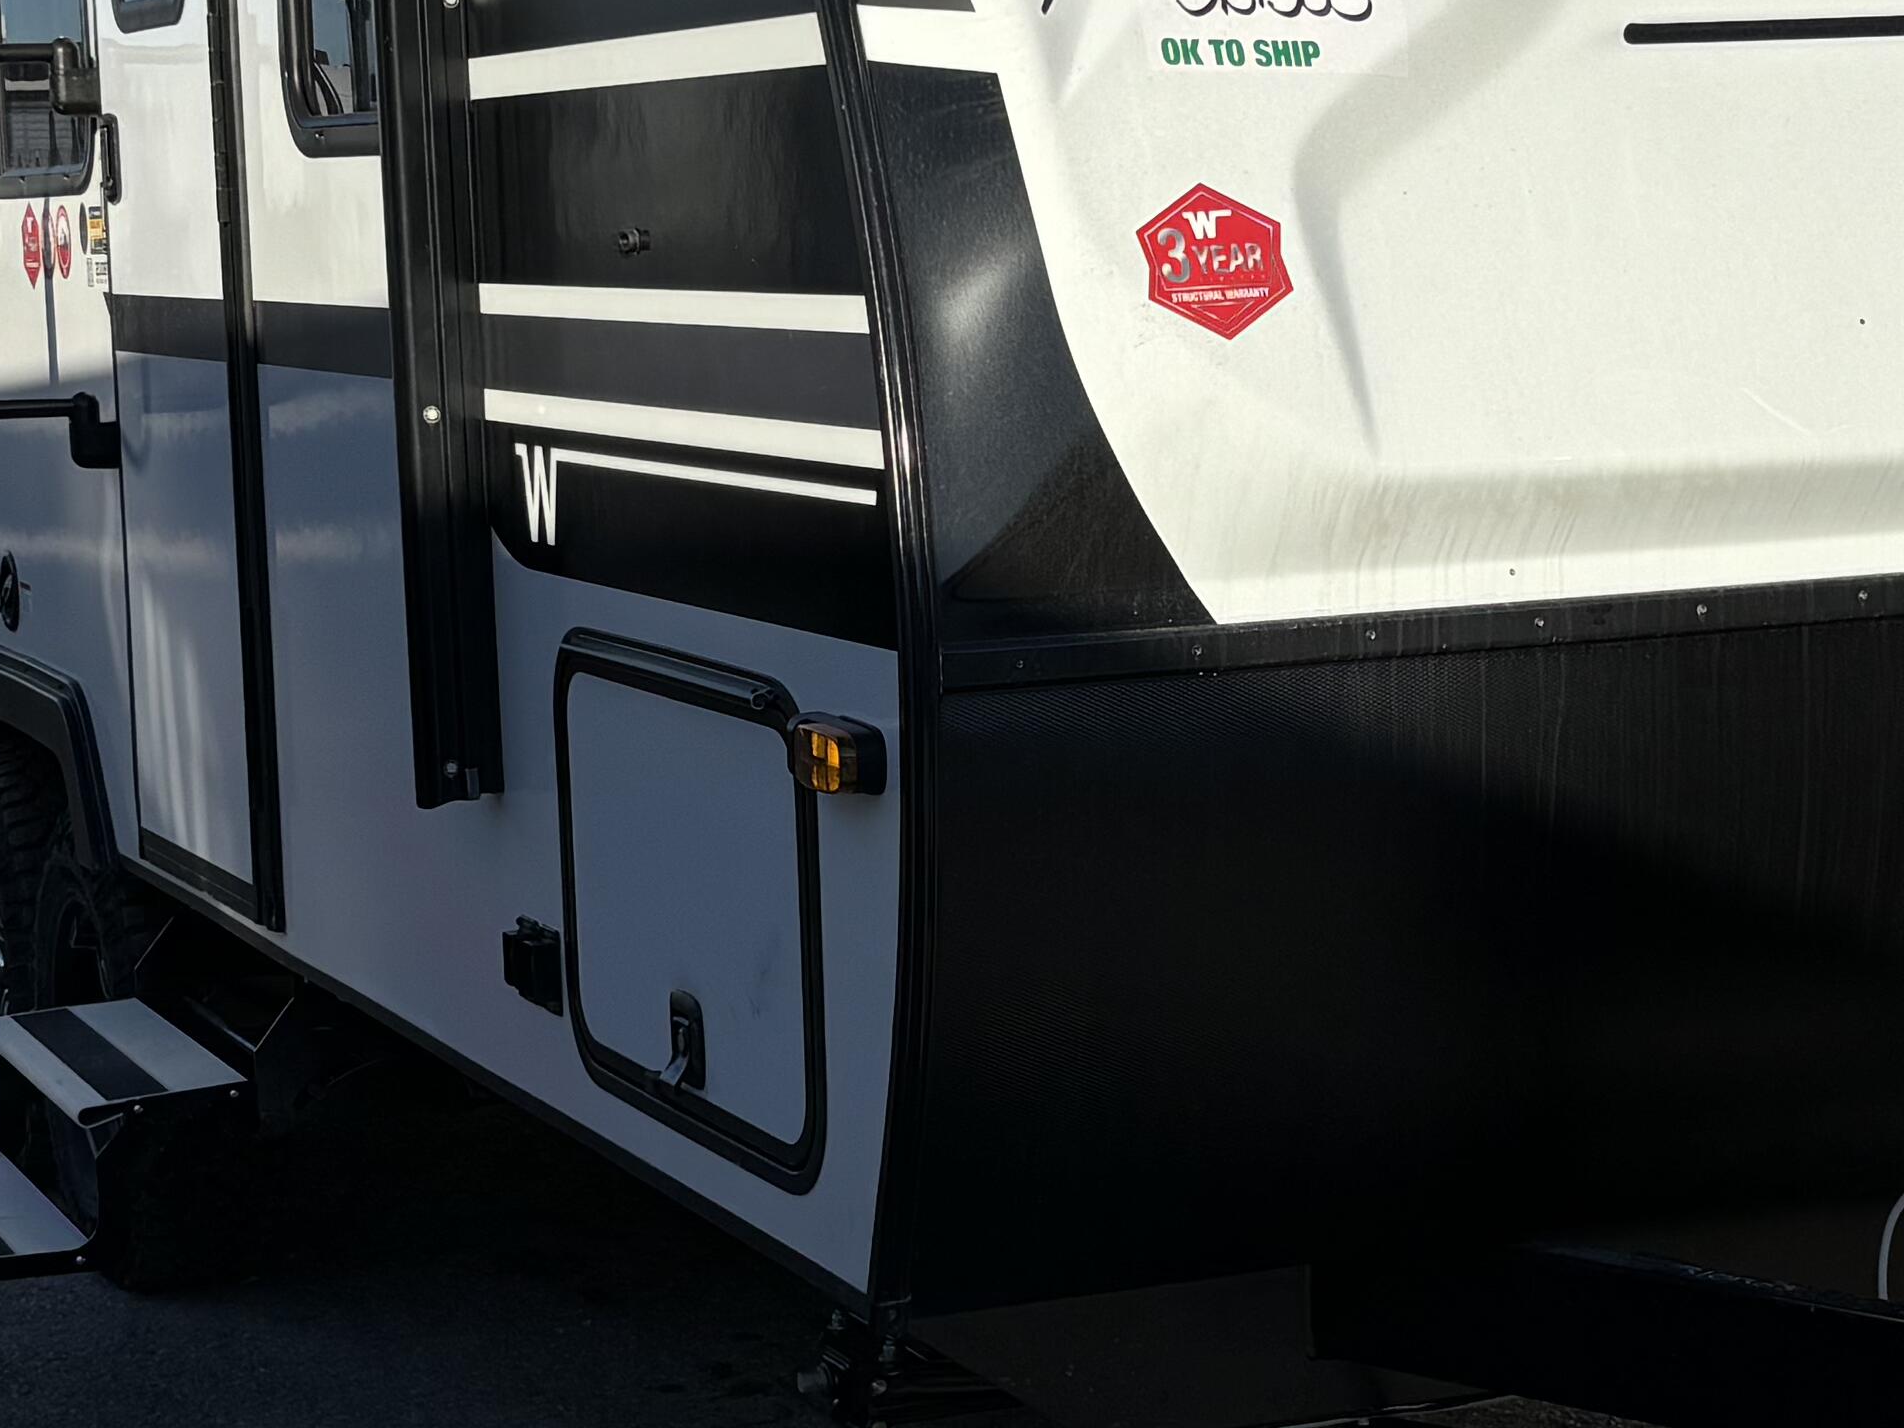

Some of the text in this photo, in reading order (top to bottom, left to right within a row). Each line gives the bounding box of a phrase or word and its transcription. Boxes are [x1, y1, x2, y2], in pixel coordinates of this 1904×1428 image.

[1161, 37, 1321, 68] OK TO SHIP
[1157, 228, 1264, 283] 3 YEAR
